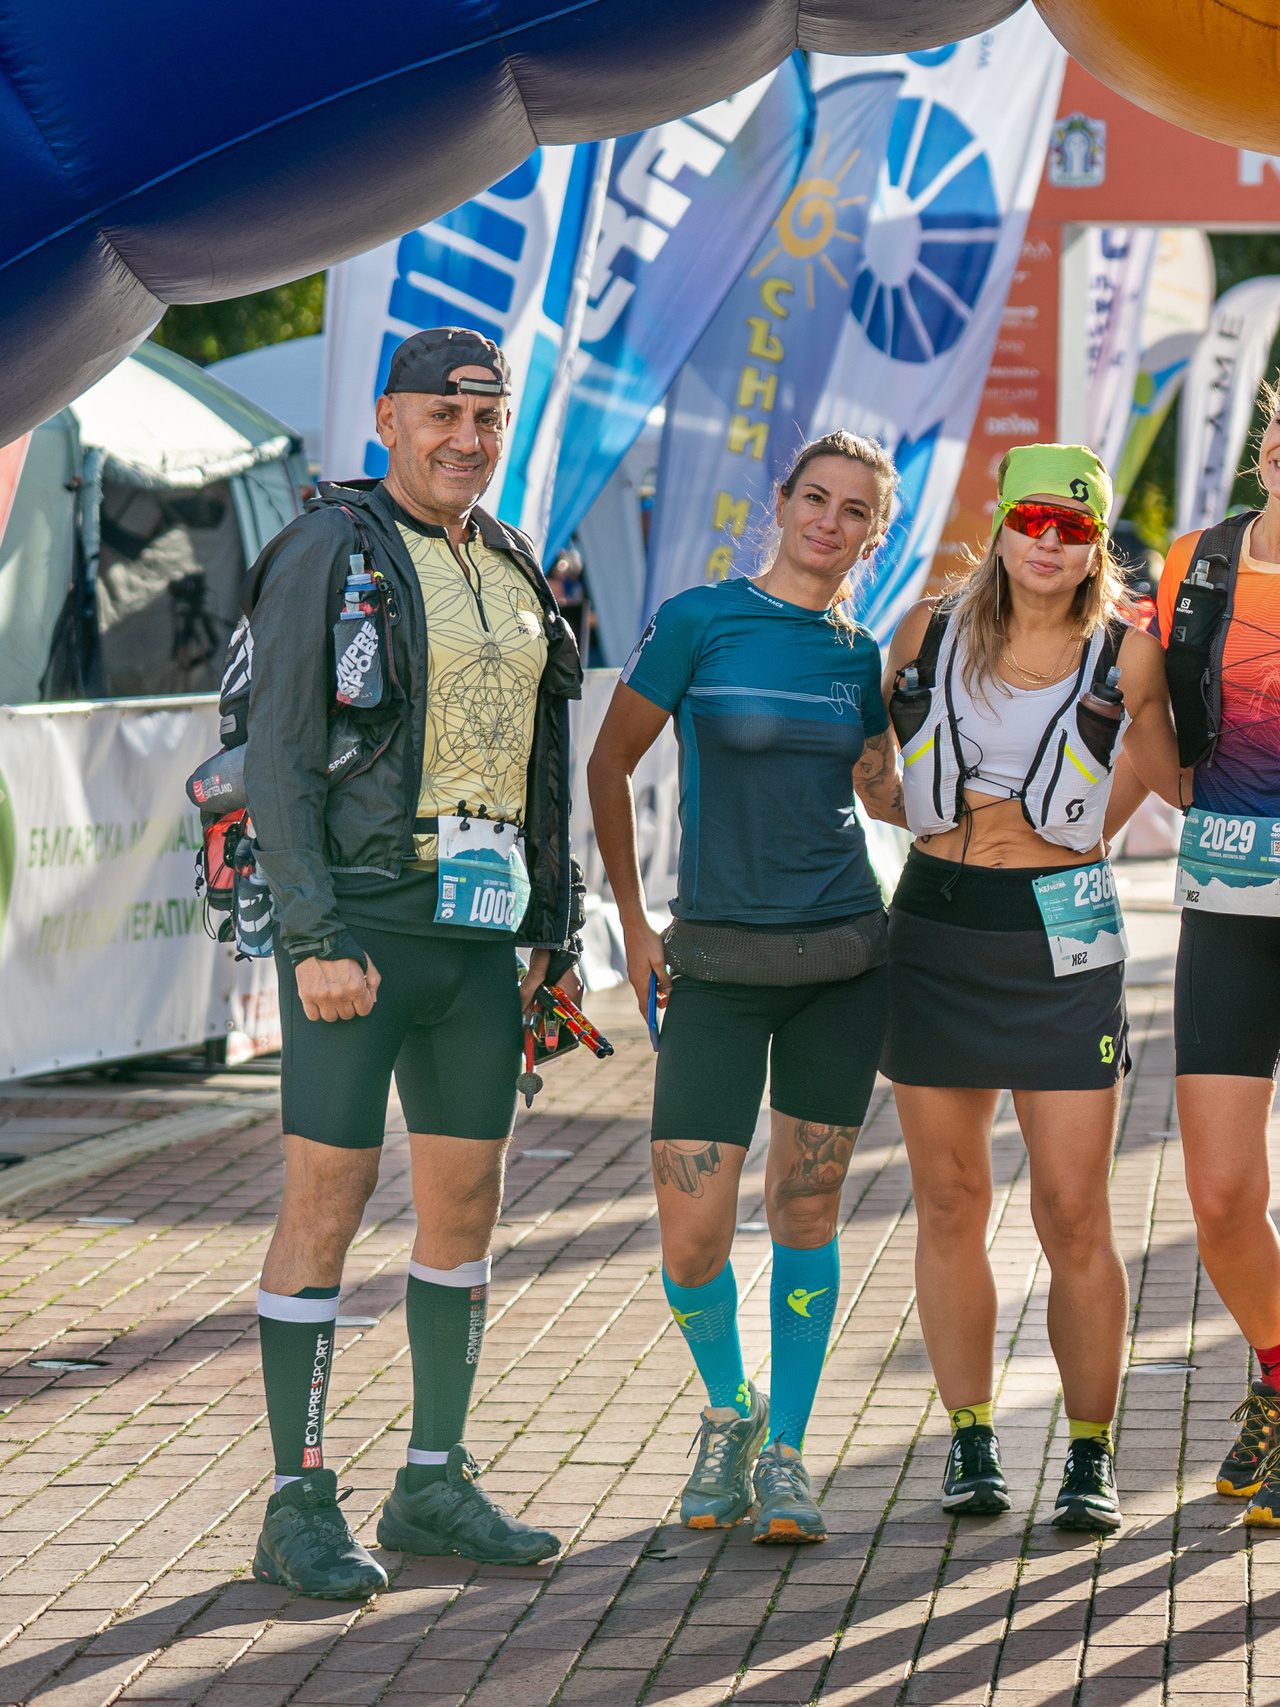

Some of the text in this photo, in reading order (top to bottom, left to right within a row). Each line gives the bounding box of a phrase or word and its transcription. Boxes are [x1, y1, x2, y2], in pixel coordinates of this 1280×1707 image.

[767, 598, 784, 609] RACE
[1199, 815, 1257, 854] 2029
[469, 886, 517, 927] 2001
[1071, 951, 1088, 967] 23K
